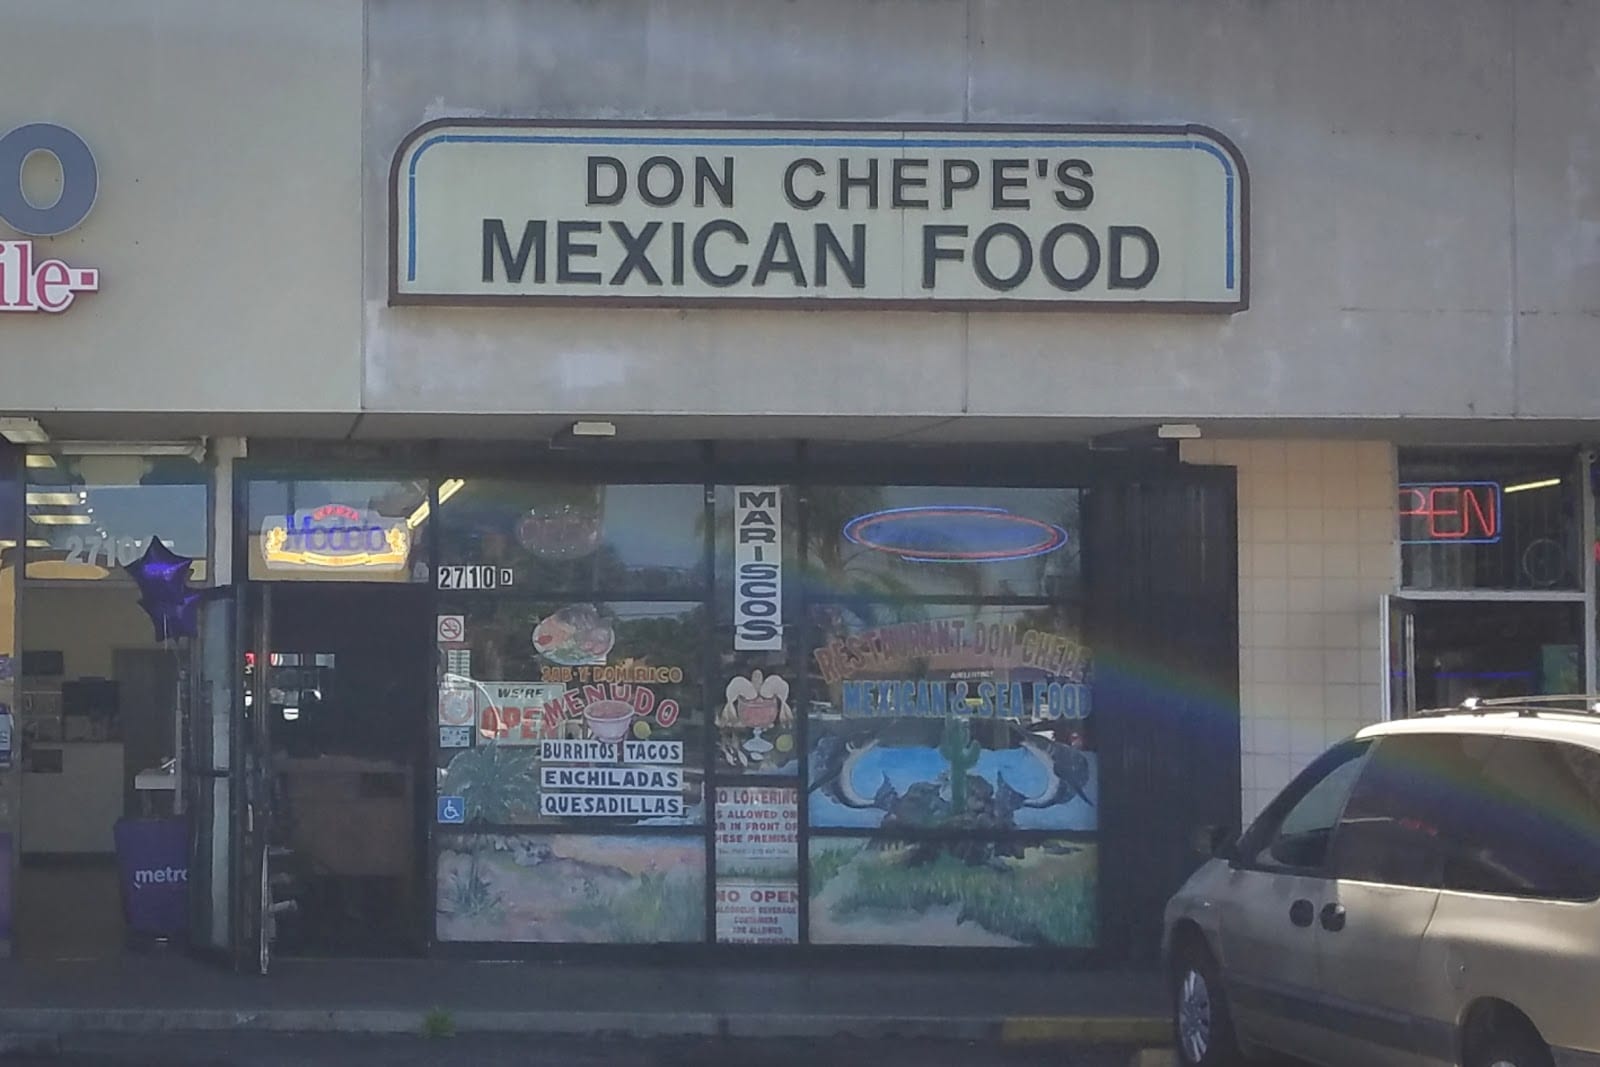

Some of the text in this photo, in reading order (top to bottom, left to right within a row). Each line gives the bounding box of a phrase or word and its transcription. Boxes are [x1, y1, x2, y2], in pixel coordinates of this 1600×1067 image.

[586, 156, 1094, 210] DON CHEPE'S
[482, 219, 1160, 291] MEXICAN FOOD
[739, 491, 779, 641] MARISCOS
[439, 567, 511, 589] 2710 D
[544, 684, 680, 728] MENUDO
[842, 680, 1093, 721] MEXICAN & SEA FOOD
[543, 743, 680, 761] BURRITOS TACOS
[544, 771, 679, 788] ENCHILADAS
[545, 798, 679, 815] QUESADILLAS
[727, 810, 778, 819] ALLOWED
[746, 822, 780, 831] FRONT
